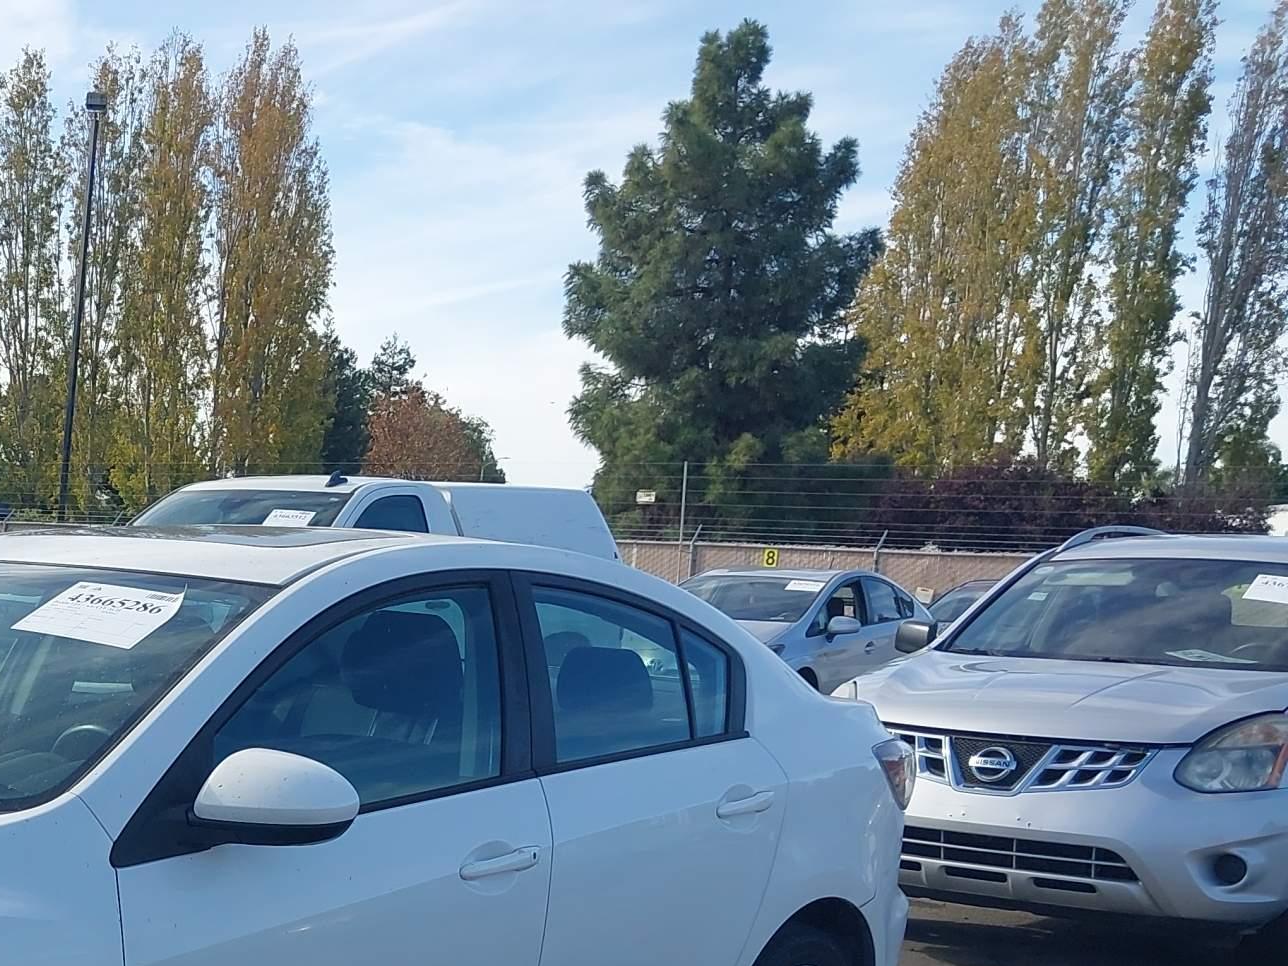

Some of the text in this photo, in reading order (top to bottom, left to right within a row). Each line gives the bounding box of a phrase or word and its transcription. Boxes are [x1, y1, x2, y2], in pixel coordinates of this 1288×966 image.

[766, 550, 776, 566] 8
[68, 592, 163, 616] 43665286
[973, 759, 1010, 767] NISSAN
